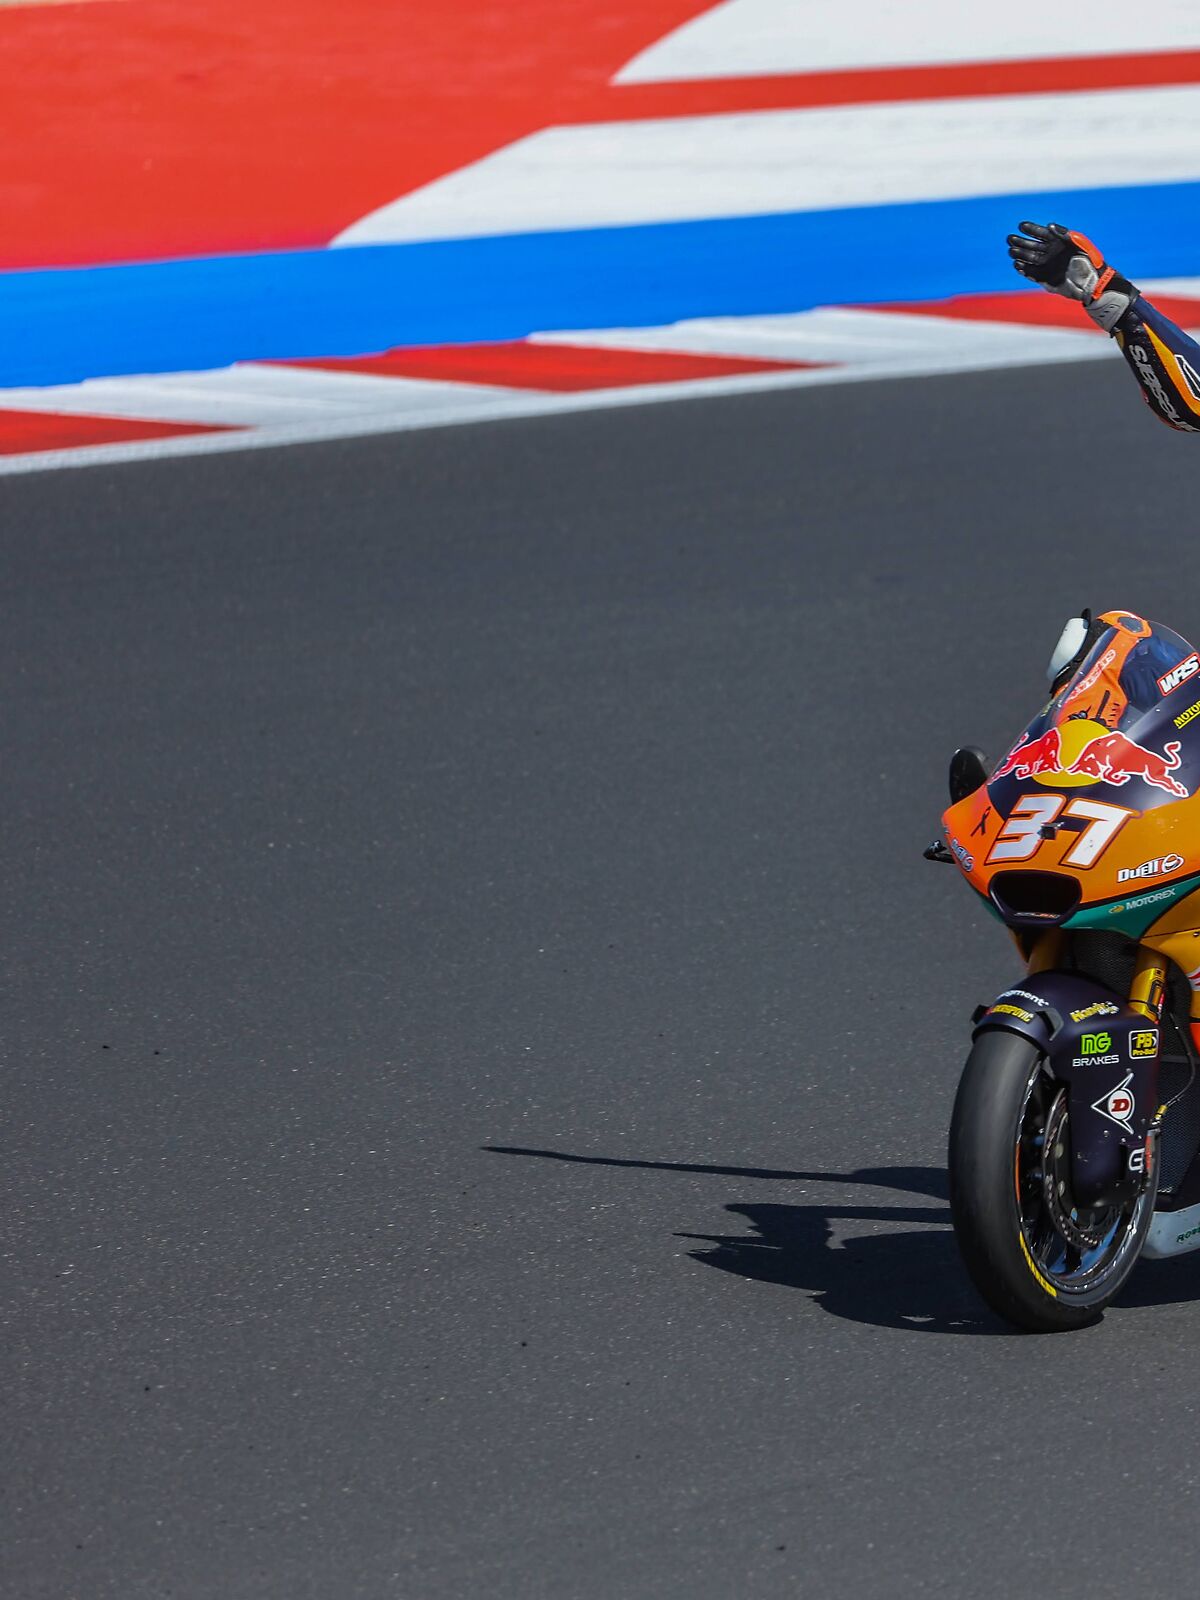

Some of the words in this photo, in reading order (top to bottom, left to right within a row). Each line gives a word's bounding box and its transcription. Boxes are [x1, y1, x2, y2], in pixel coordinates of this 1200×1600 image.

[1160, 655, 1200, 692] WRS
[988, 794, 1135, 868] 37
[1126, 888, 1176, 910] MOTOREX
[1136, 1033, 1153, 1048] PB
[1072, 1055, 1120, 1066] BRAKES
[1111, 1099, 1130, 1112] D
